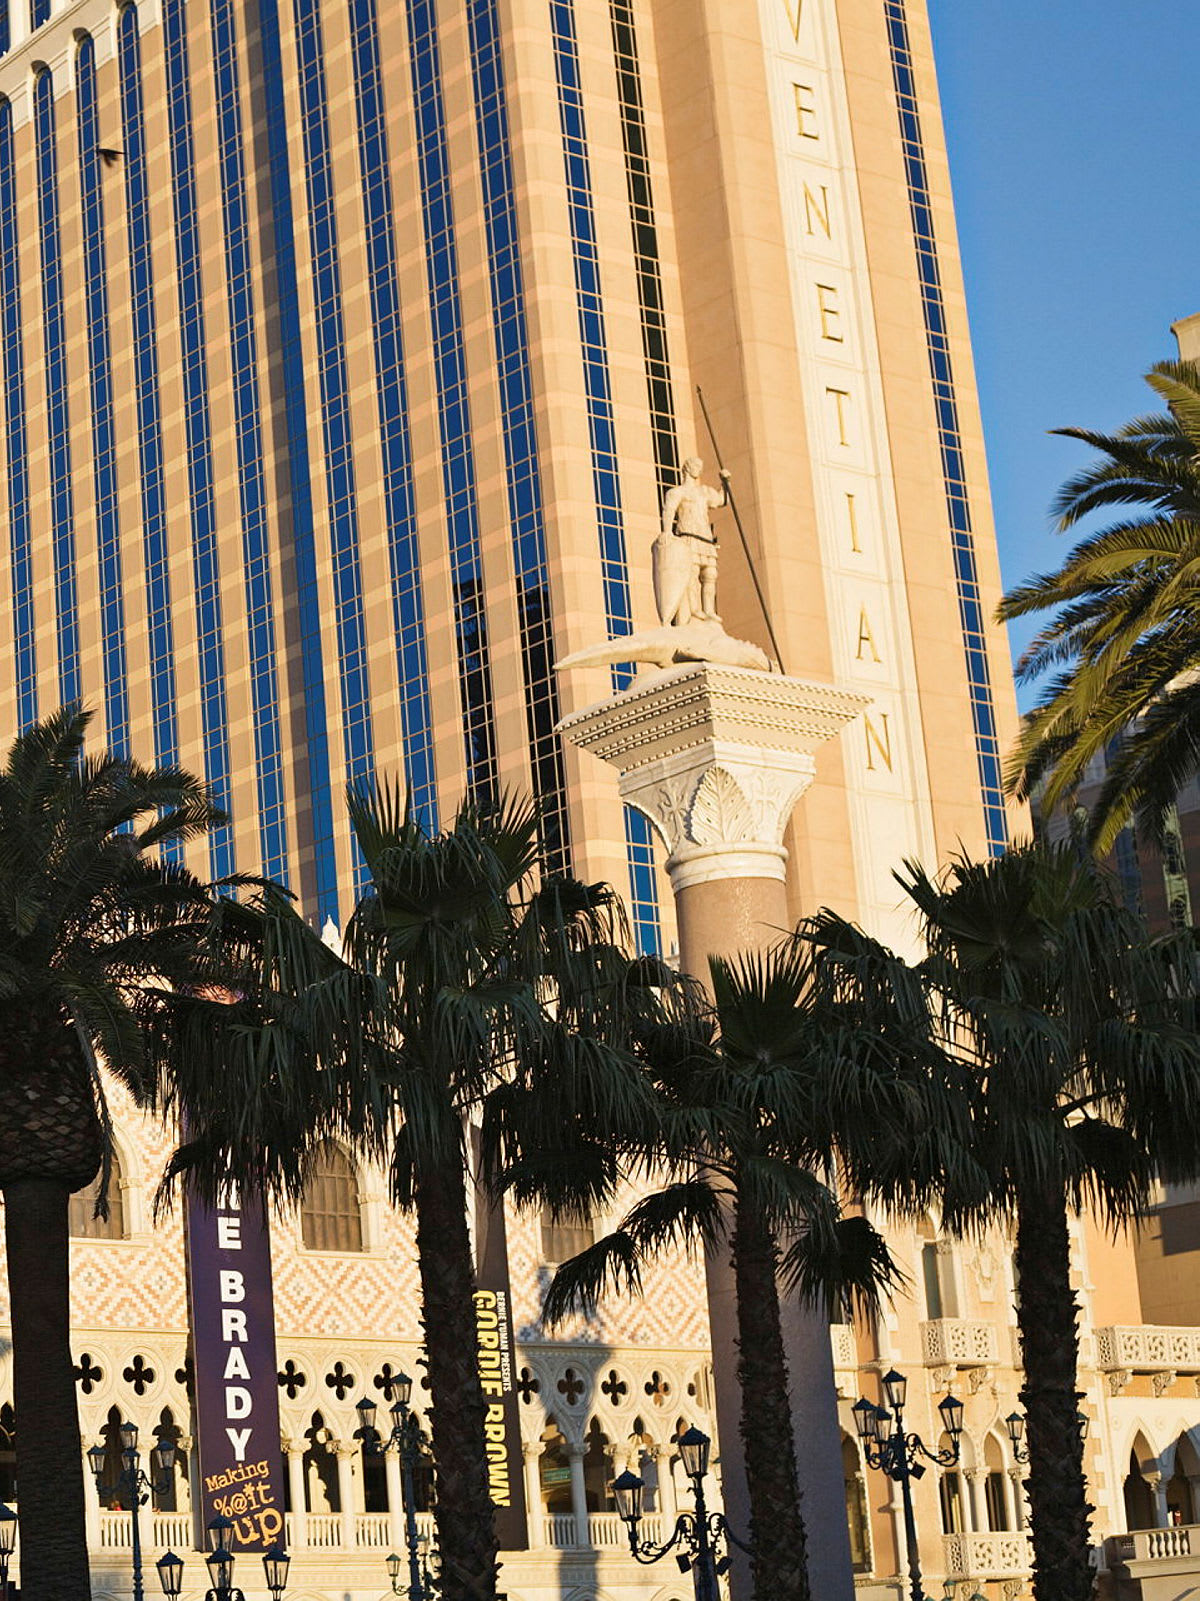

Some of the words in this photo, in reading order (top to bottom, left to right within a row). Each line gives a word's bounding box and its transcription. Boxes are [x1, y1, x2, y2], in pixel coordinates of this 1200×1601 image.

[782, 0, 893, 774] VENETIAN
[496, 1291, 507, 1320] BERNIE
[498, 1322, 509, 1350] YUMAN
[219, 1269, 253, 1461] BRADY
[500, 1352, 512, 1392] PRESENTS
[204, 1460, 270, 1493] Making
[231, 1507, 283, 1547] up
